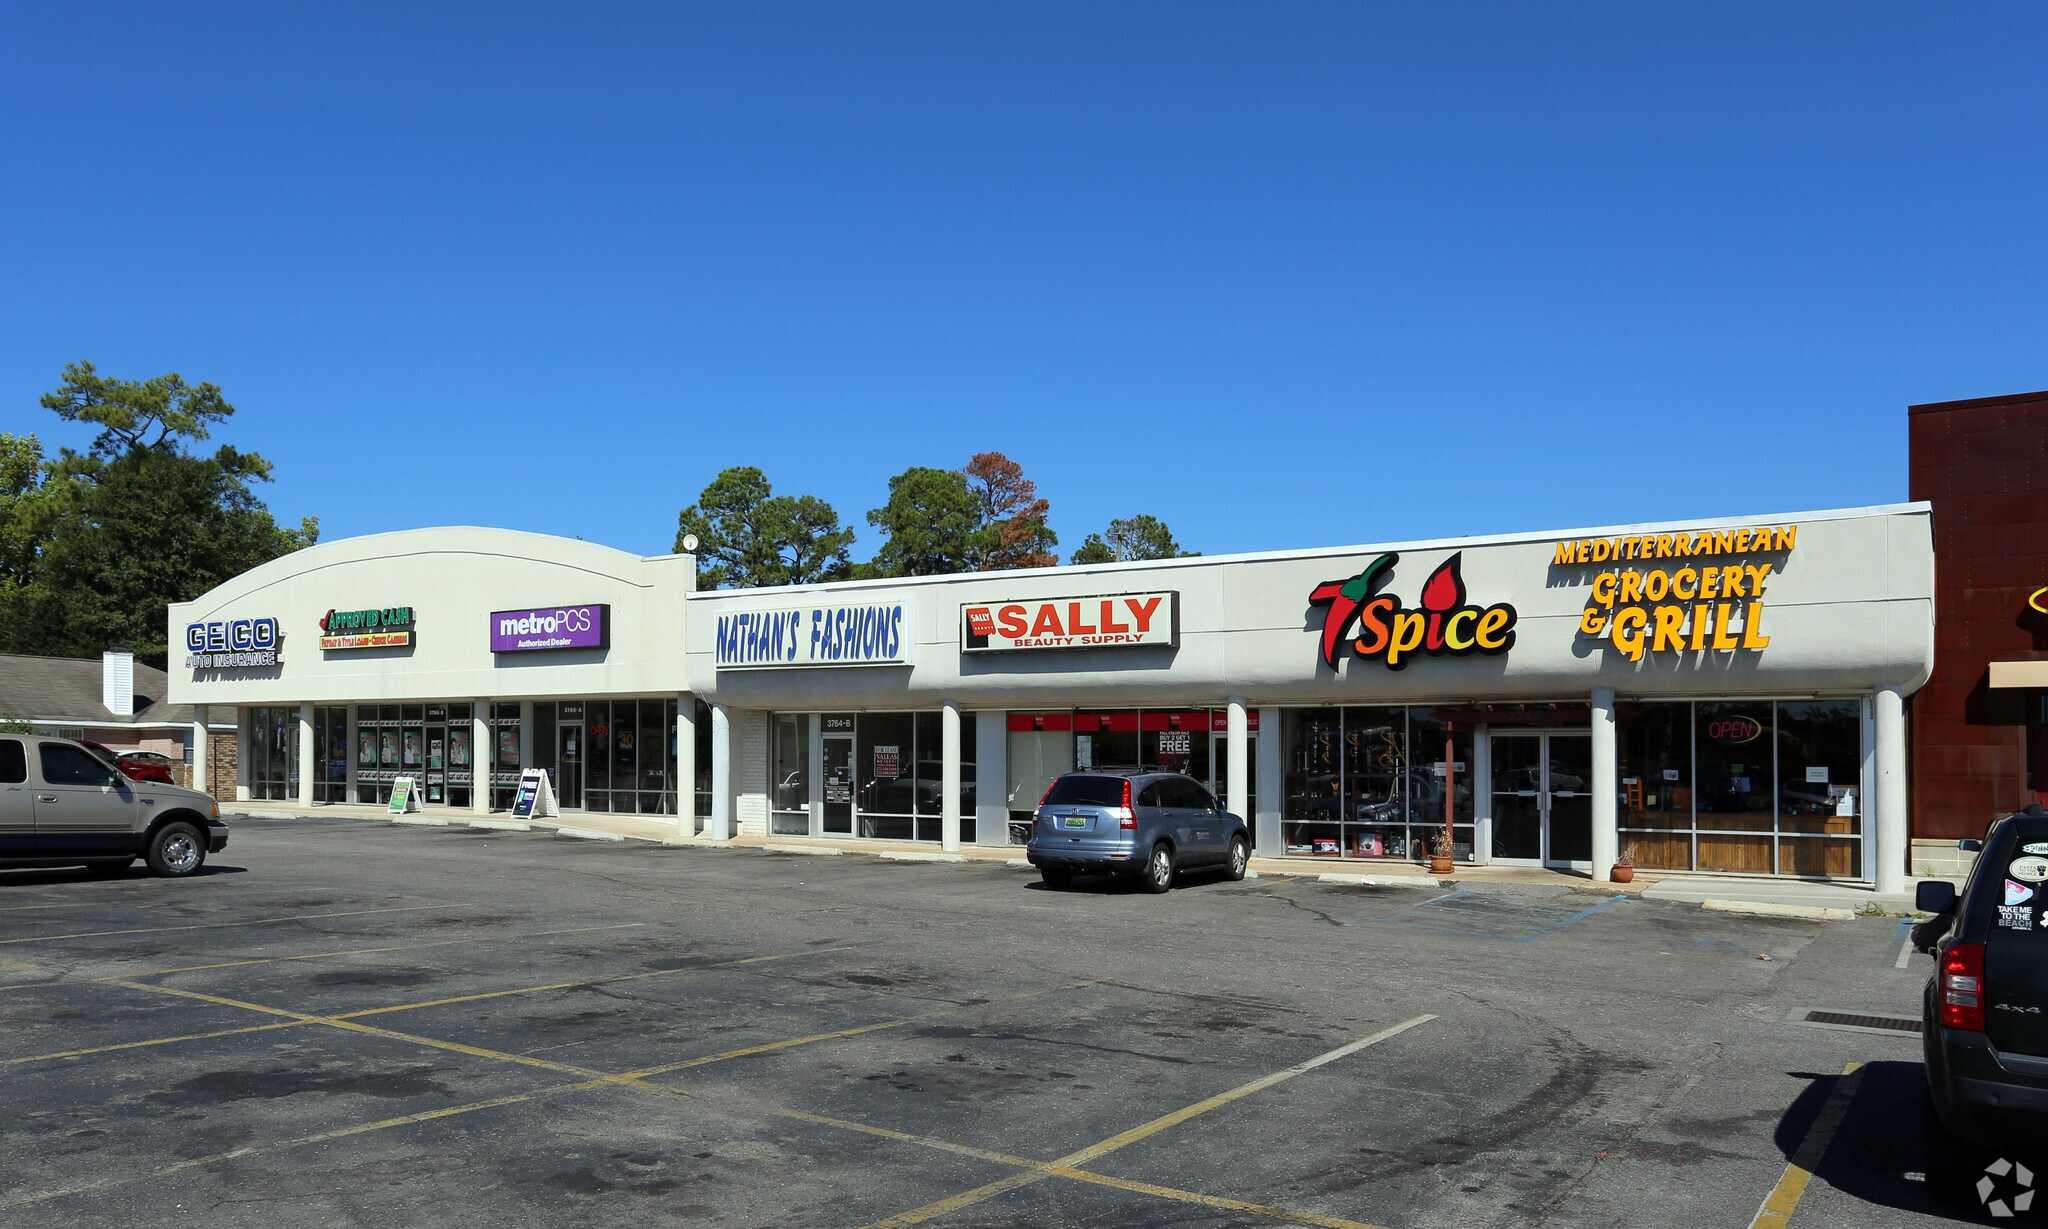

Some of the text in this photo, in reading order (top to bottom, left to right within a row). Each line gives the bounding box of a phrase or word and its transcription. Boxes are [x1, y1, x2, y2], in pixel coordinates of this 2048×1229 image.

[1554, 525, 1797, 565] MEDITERRANEAN
[1592, 563, 1773, 610] GROCERY
[328, 606, 409, 629] APPROVED CASH
[500, 608, 591, 636] metroPCS
[970, 613, 990, 622] SALLY
[997, 597, 1162, 639] SALLY
[1354, 564, 1510, 666] Spice
[186, 617, 276, 653] GEICO
[716, 605, 902, 664] NATHAN'S FASHIONS
[1014, 634, 1144, 647] BEAUTY SUPPLY
[1580, 602, 1770, 662] & GRILL
[517, 637, 572, 648] Authorized Dealer
[185, 651, 276, 669] AUTO INSURANCE
[591, 724, 610, 737] OPEN
[827, 719, 851, 728] 3764-B
[1709, 721, 1753, 739] OPEN
[1160, 740, 1190, 751] FREE
[521, 781, 538, 789] FREE
[1997, 905, 2032, 914] TAKE ME
[2001, 912, 2031, 921] TO THE
[1998, 918, 2032, 927] BEACH
